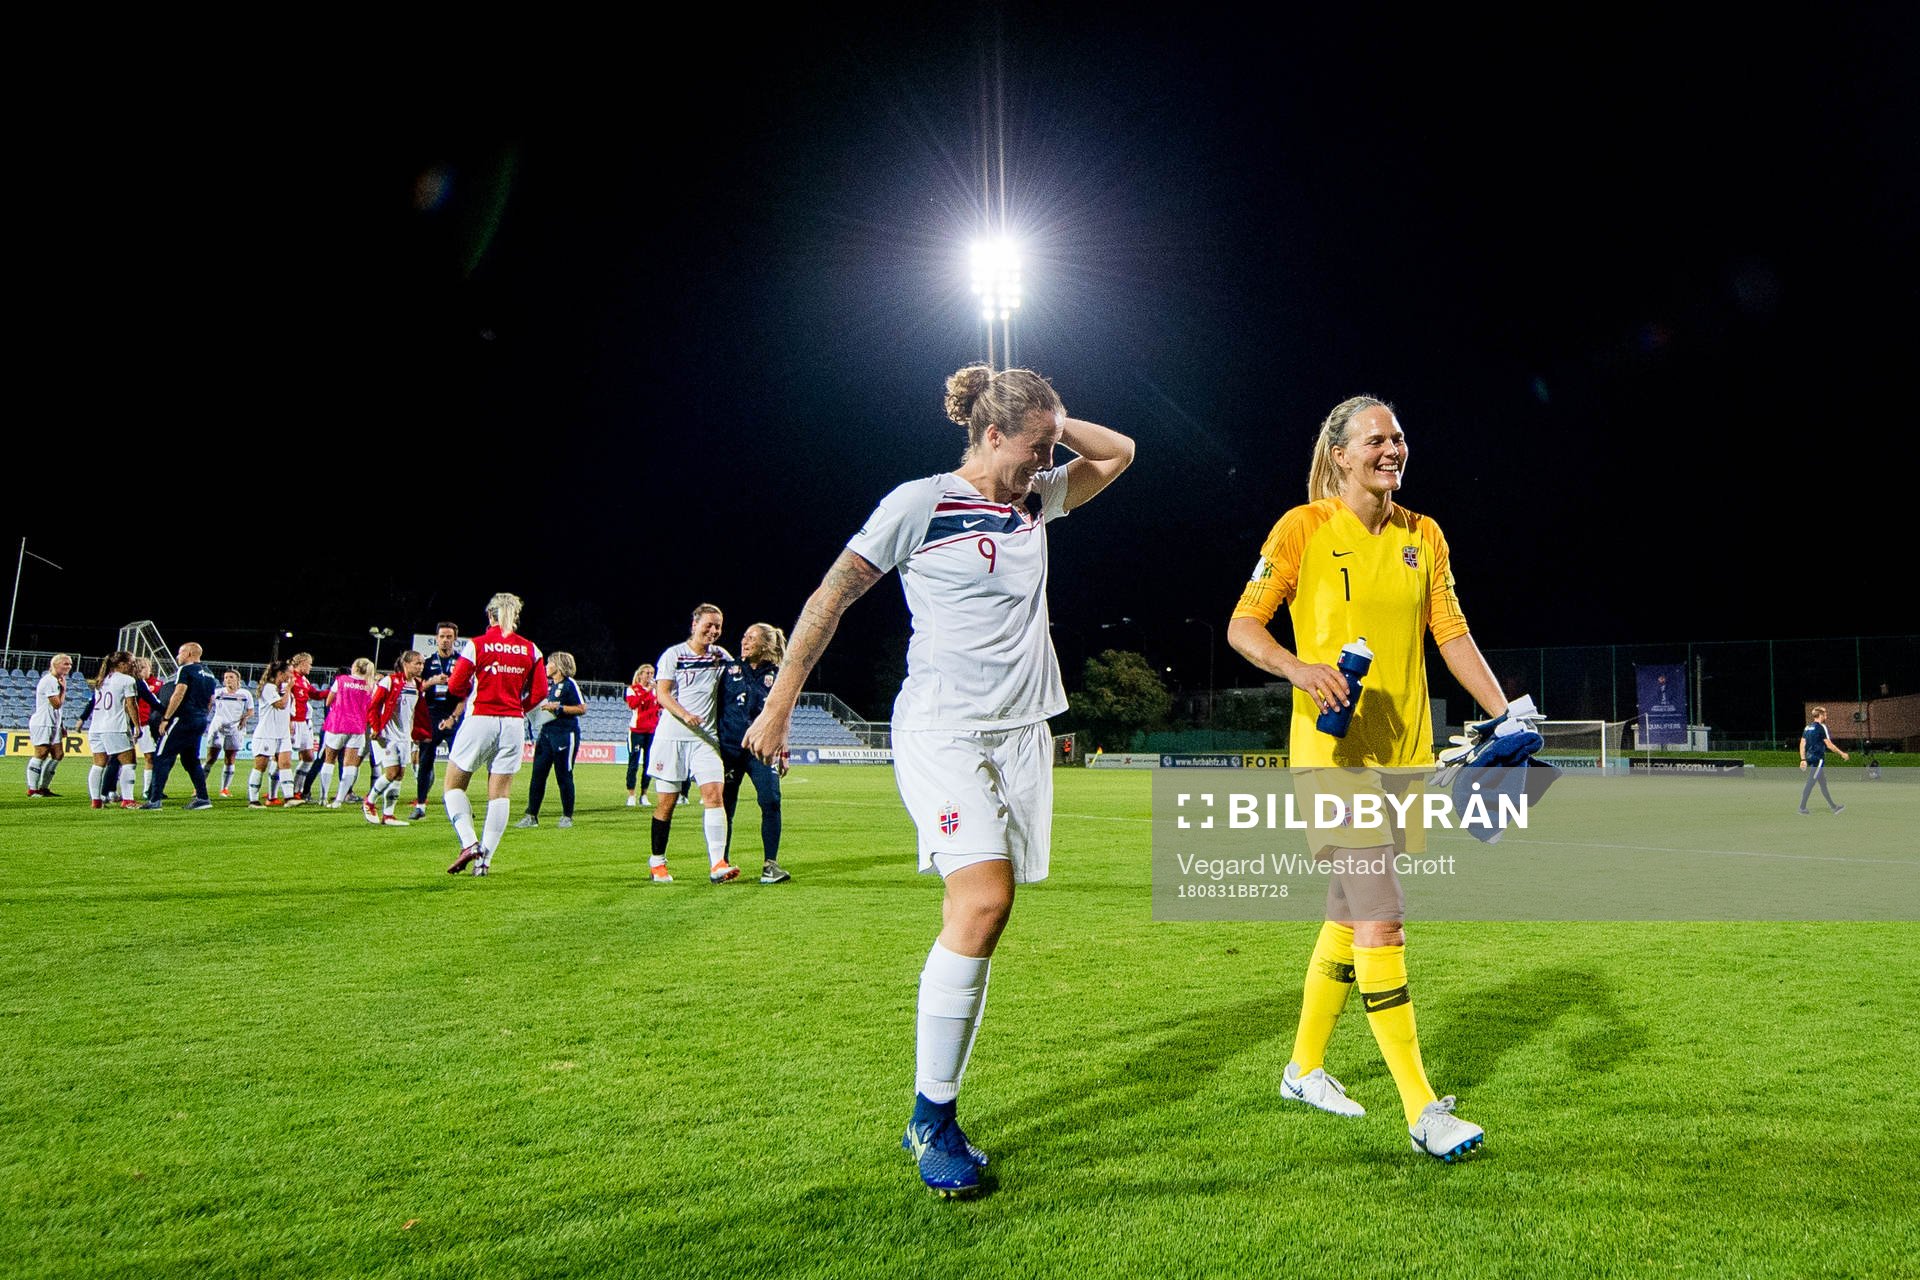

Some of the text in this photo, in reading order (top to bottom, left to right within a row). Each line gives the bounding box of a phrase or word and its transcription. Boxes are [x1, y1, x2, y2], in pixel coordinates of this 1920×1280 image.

[977, 537, 996, 574] 9
[1340, 567, 1351, 602] 1
[484, 642, 529, 656] NORGE
[95, 691, 113, 711] 20
